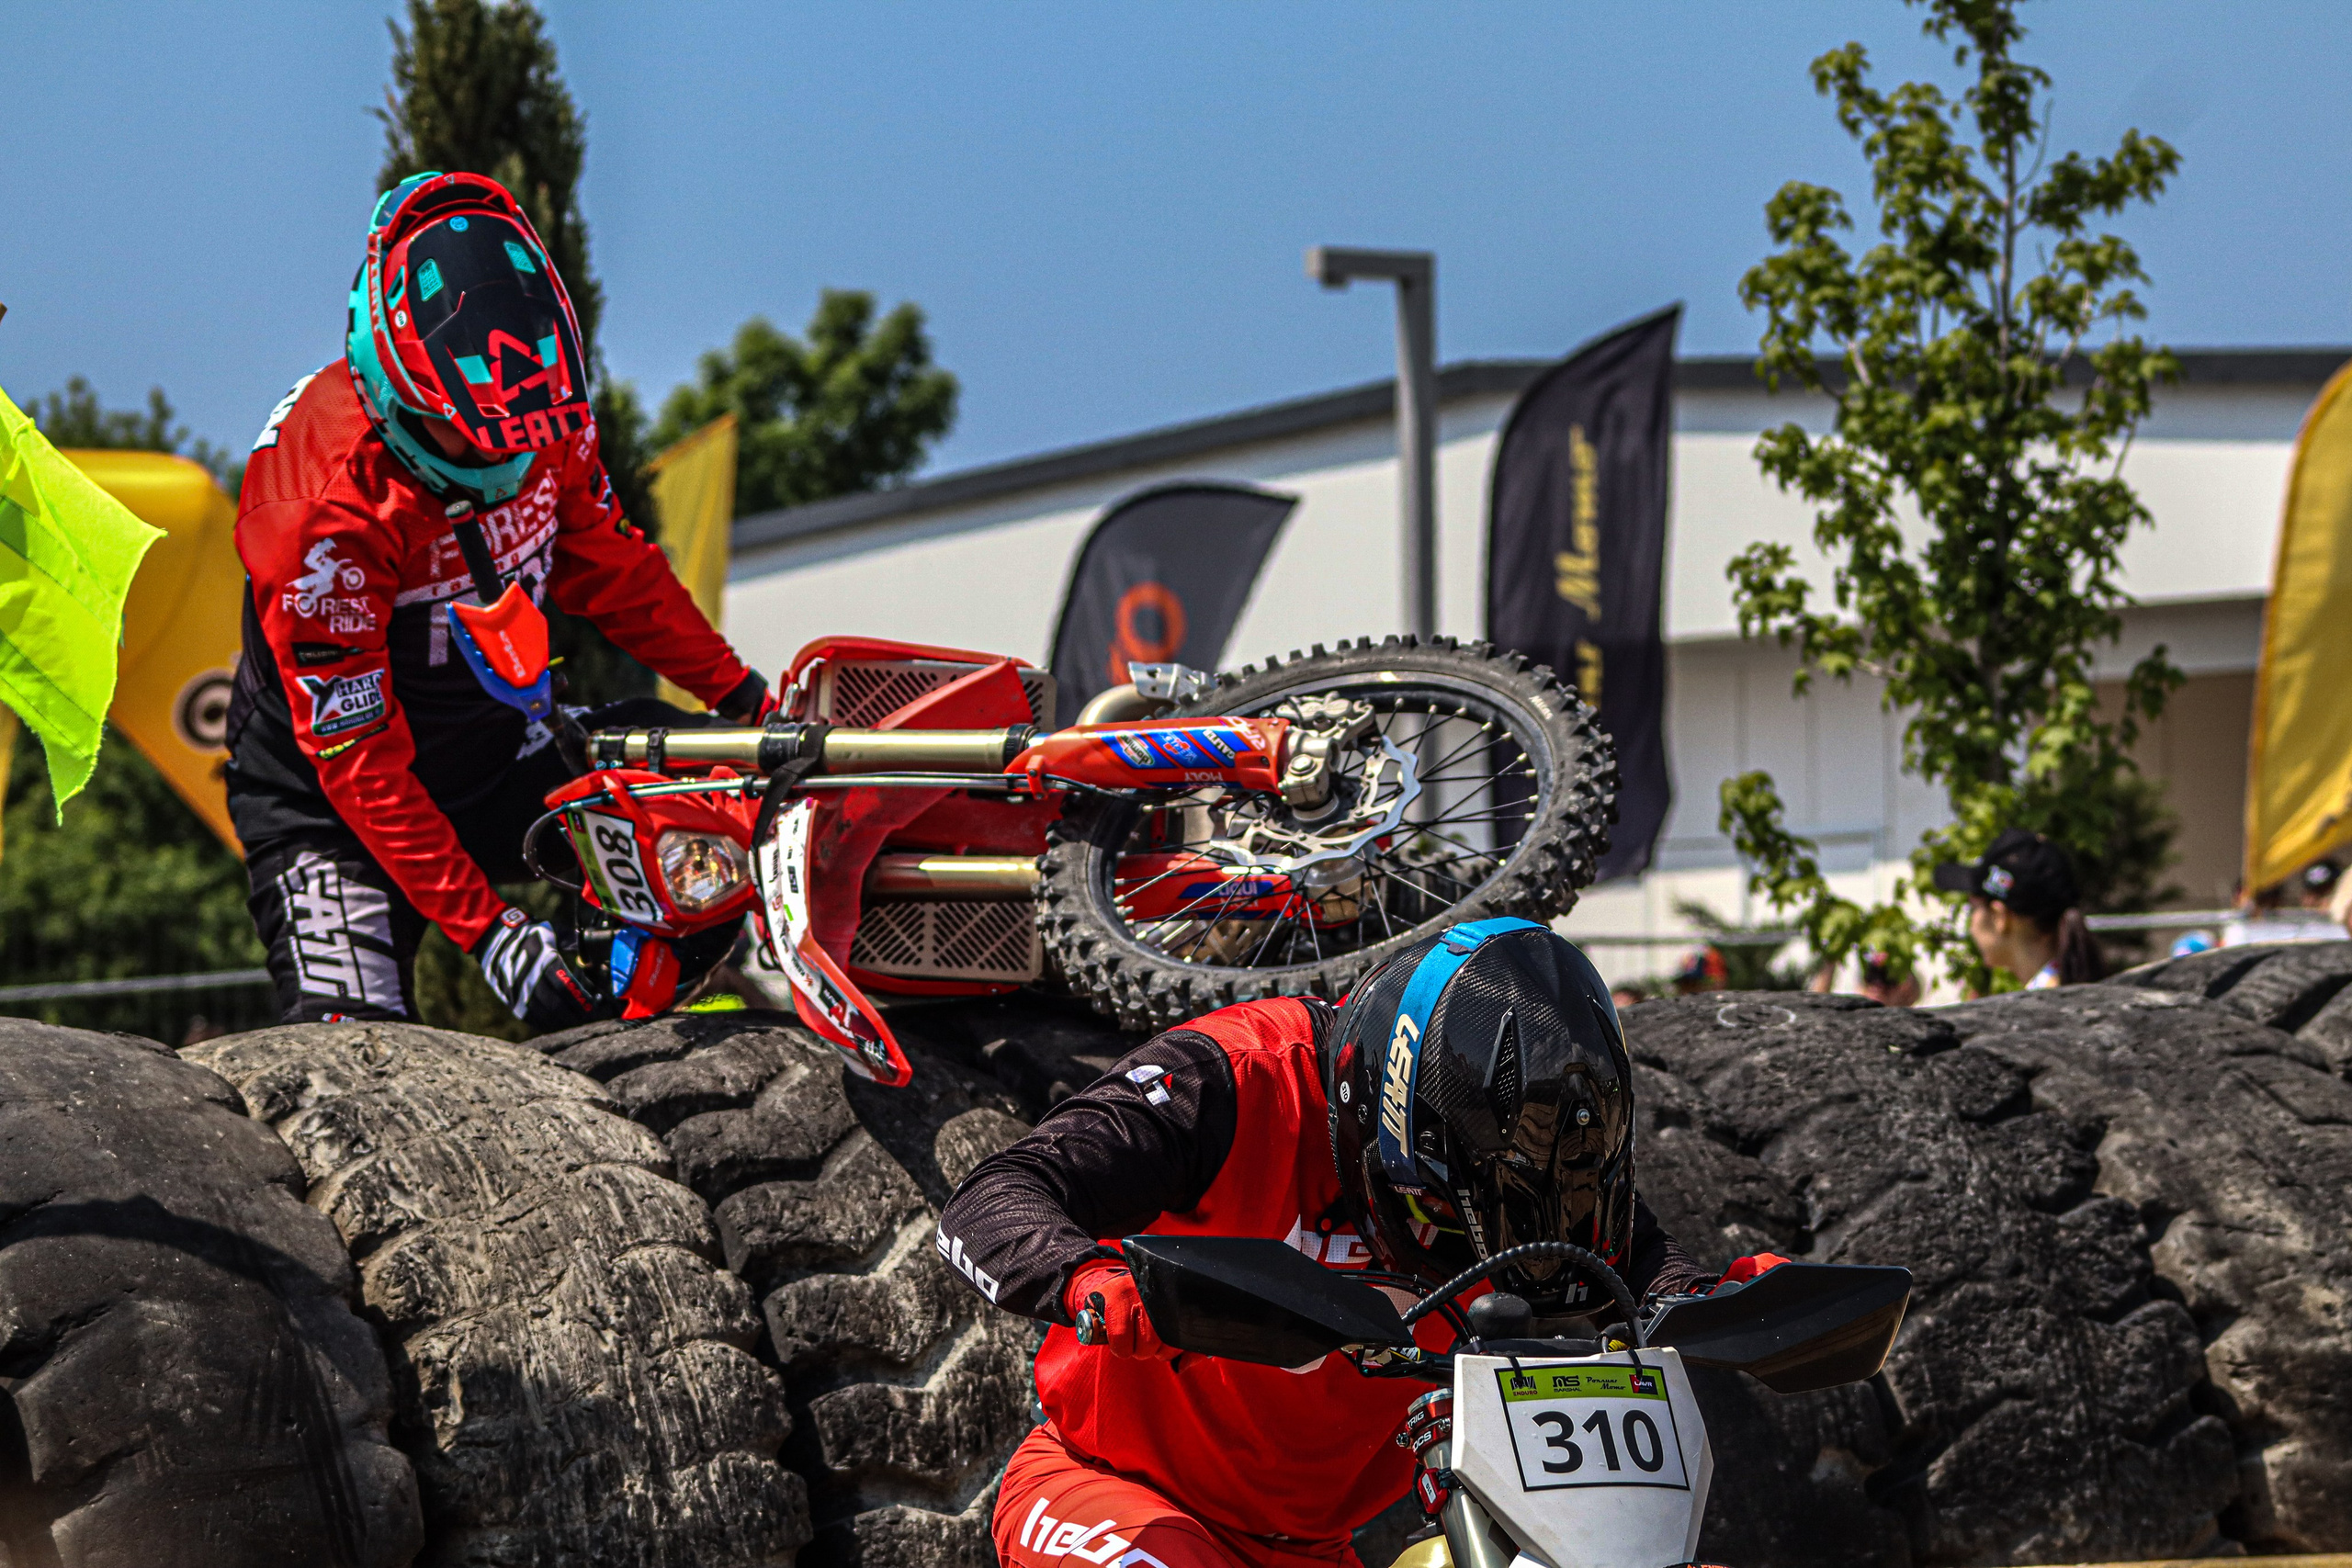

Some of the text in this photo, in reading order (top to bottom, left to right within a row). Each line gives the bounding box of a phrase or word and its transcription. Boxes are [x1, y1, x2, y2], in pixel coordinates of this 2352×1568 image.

[476, 401, 590, 448] LEATT
[329, 614, 376, 634] RIDE
[595, 825, 658, 921] 308
[1382, 1013, 1419, 1158] LEATT
[1394, 1185, 1423, 1196] LEATT
[1532, 1409, 1664, 1473] 310
